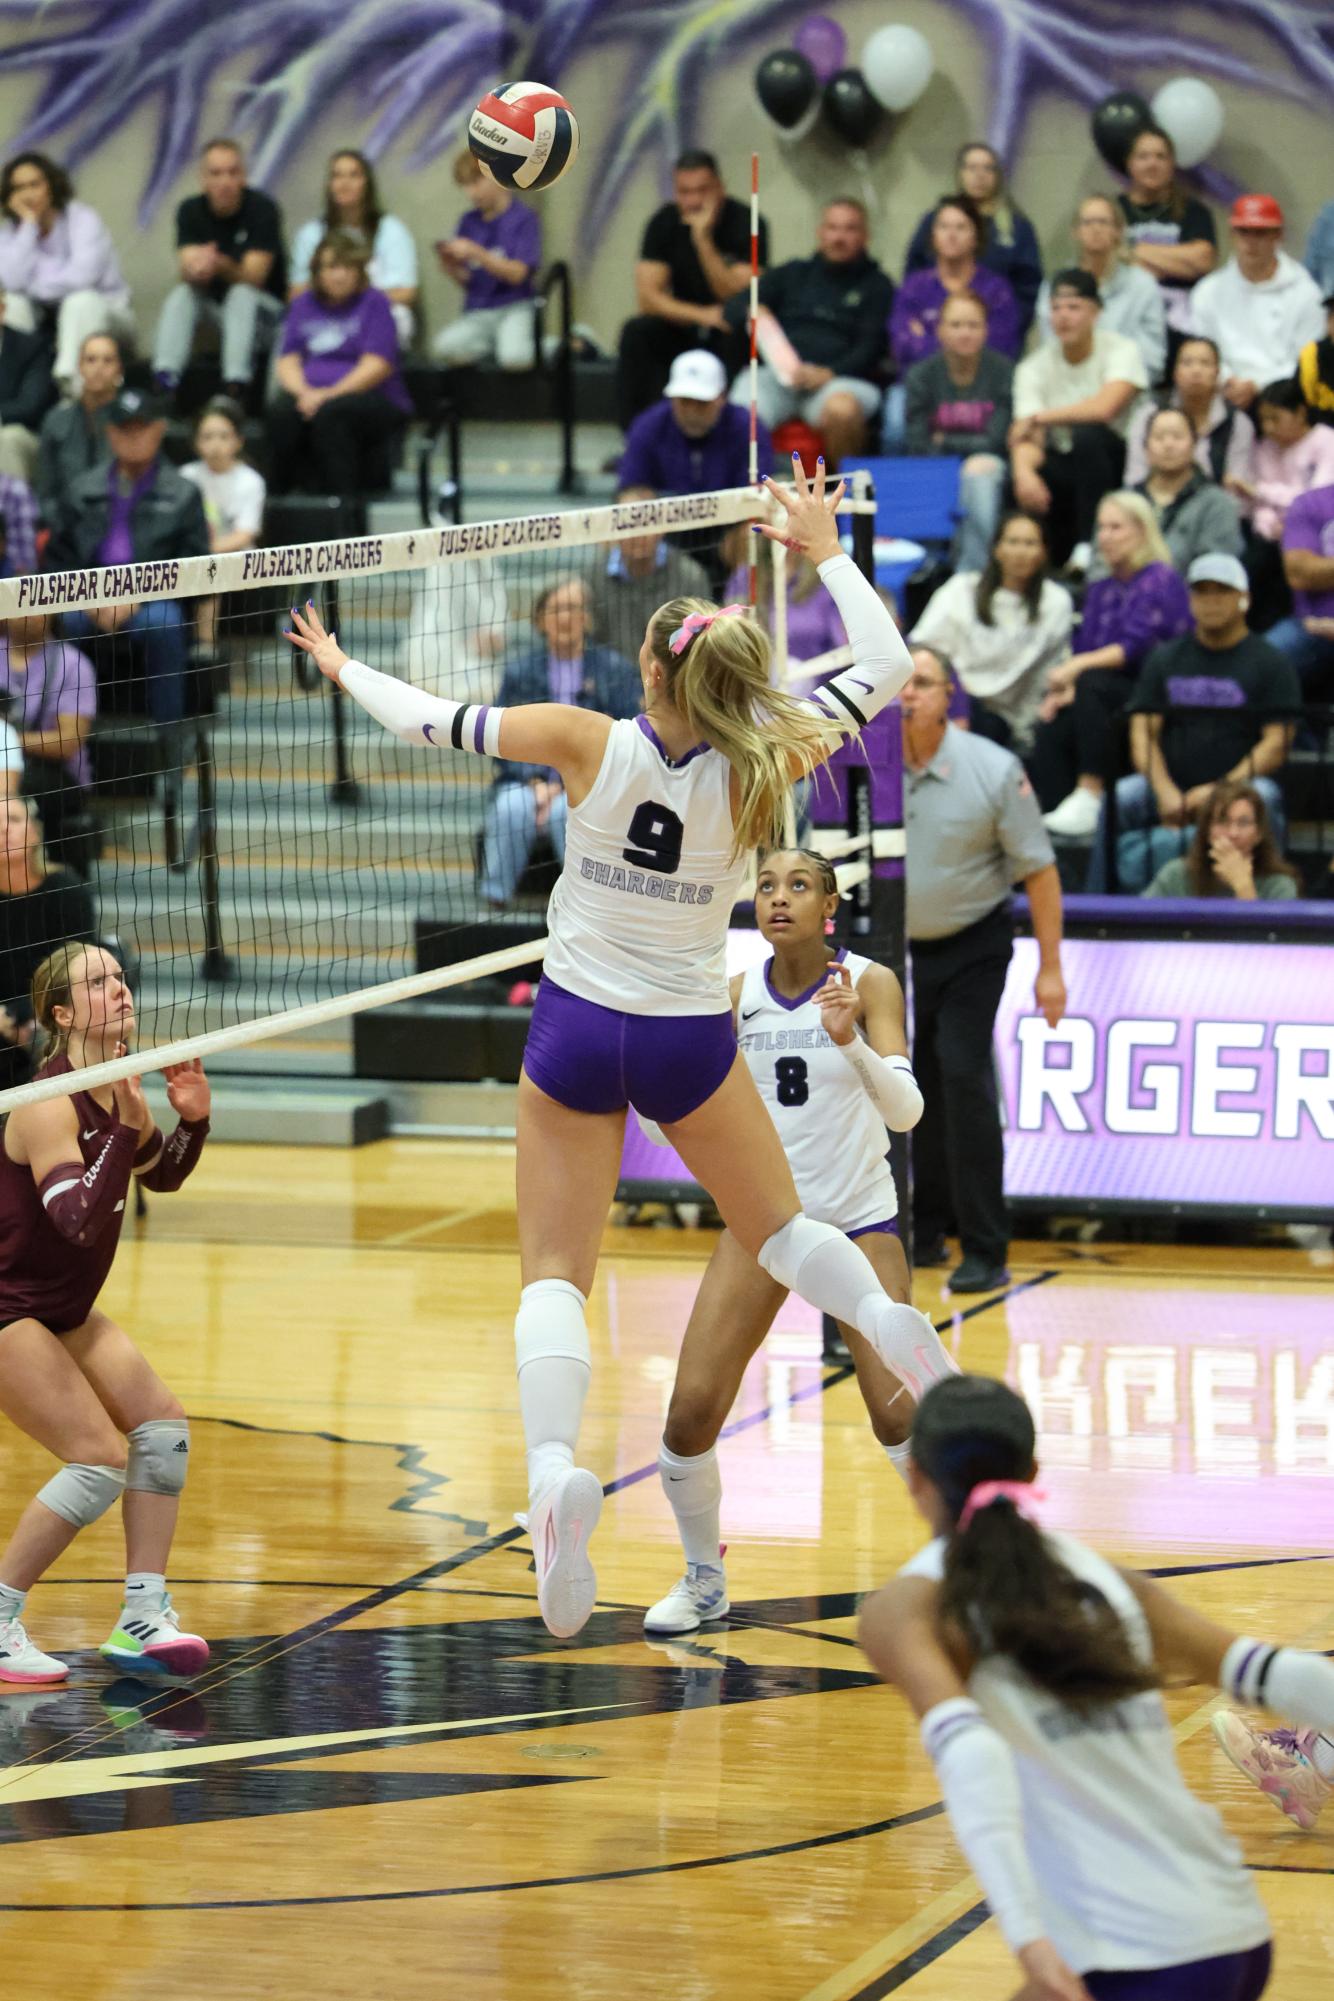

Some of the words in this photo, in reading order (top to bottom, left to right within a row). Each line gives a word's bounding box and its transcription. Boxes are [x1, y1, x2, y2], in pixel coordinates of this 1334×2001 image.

[471, 118, 508, 146] Baden
[18, 570, 98, 608] FULSHEAR
[104, 561, 179, 598] CHARGERS
[622, 800, 684, 874] 9
[580, 857, 714, 905] CHARGERS
[744, 1028, 837, 1052] FULSHEA
[774, 1055, 809, 1107] 8
[997, 1015, 1334, 1142] RGER
